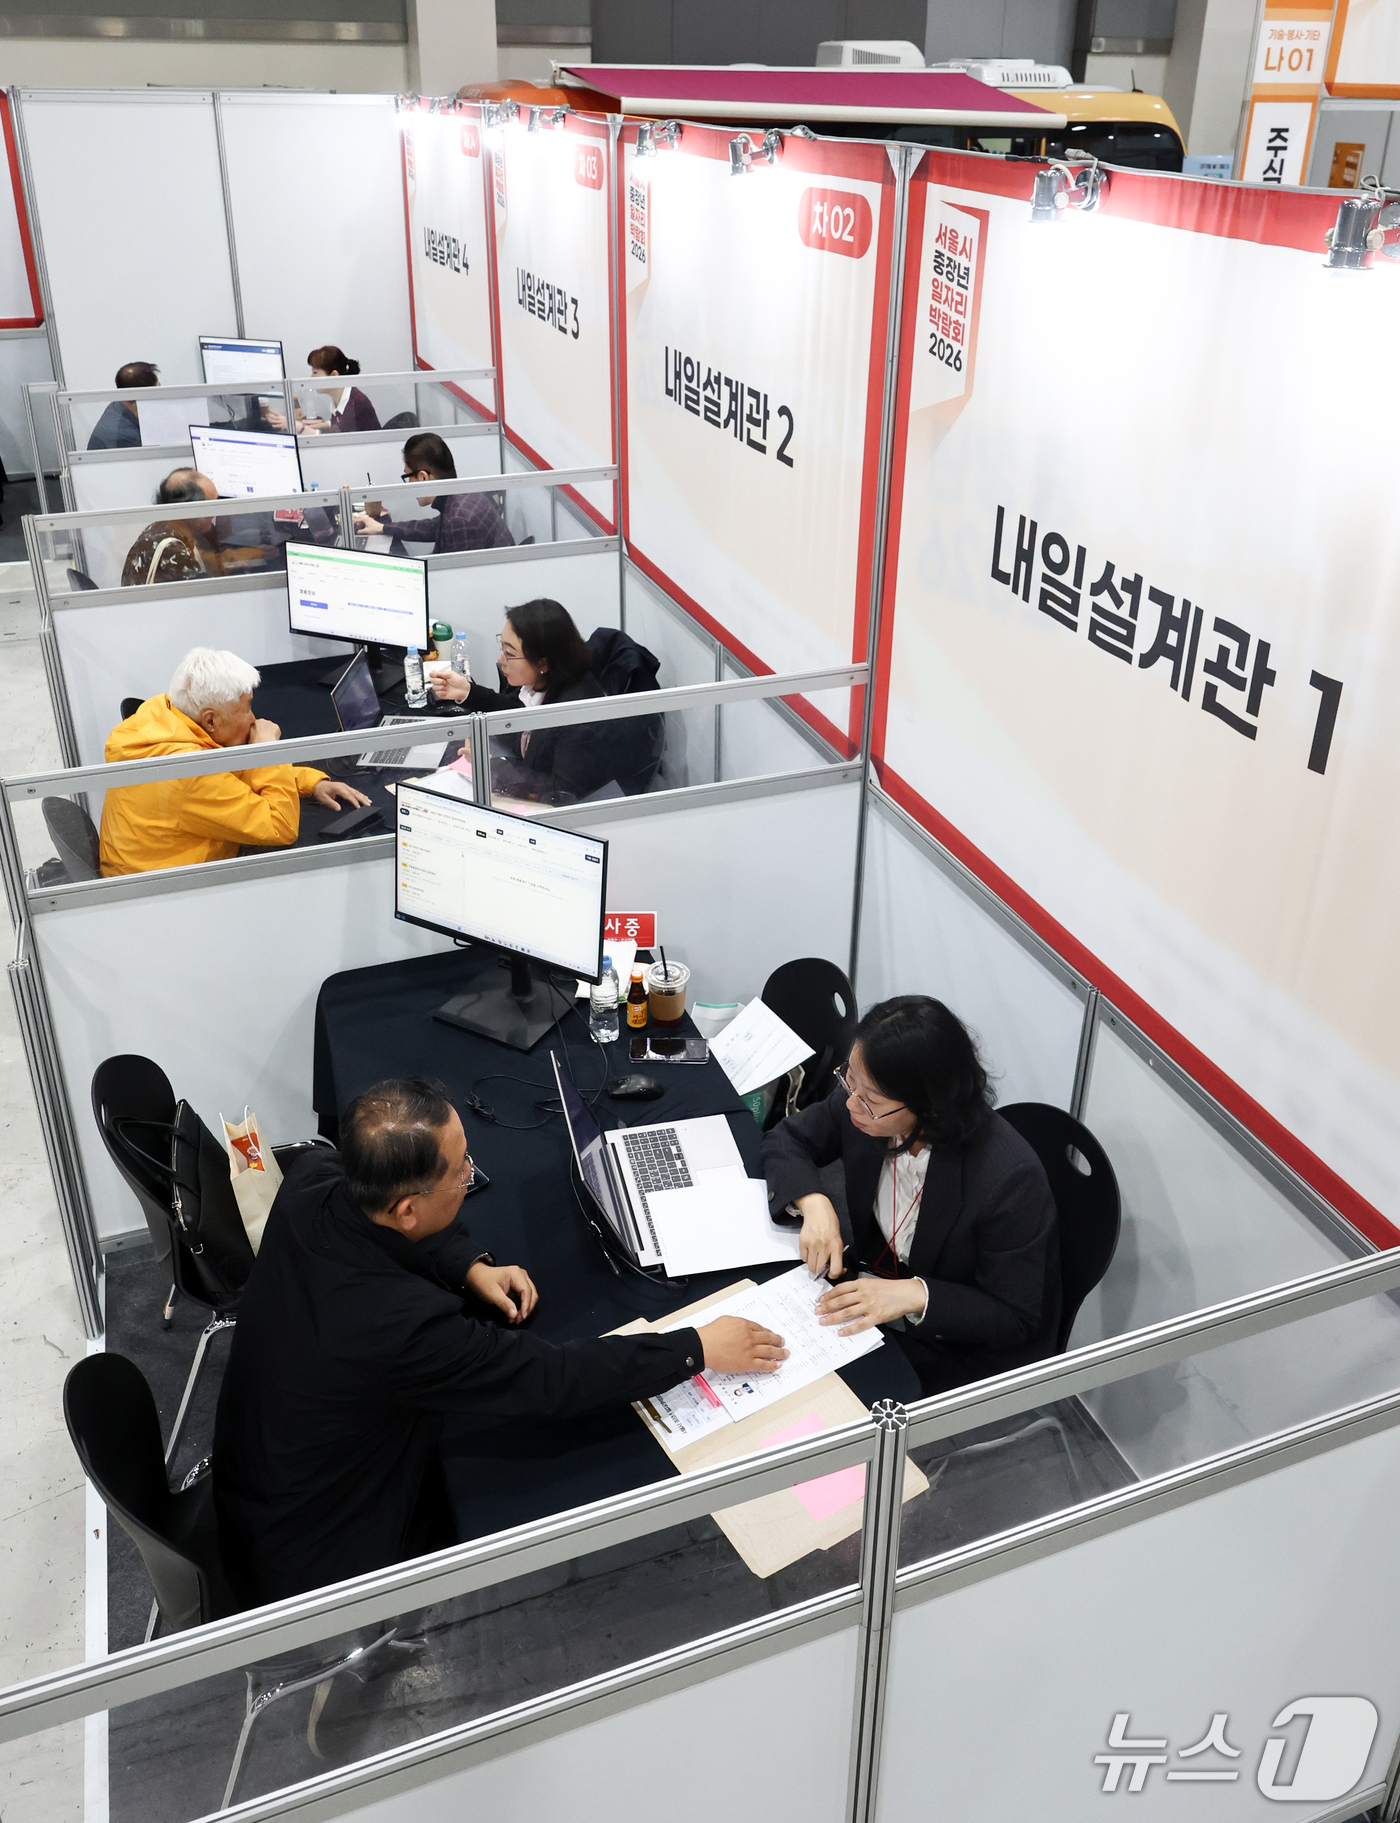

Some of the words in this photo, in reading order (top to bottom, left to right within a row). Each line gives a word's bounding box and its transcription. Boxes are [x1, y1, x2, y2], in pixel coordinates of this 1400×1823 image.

[811, 200, 856, 243] 차02
[935, 222, 973, 263] 서울시
[423, 226, 460, 274] 내일설계관
[462, 243, 469, 276] 4
[630, 240, 646, 264] 2026
[932, 249, 970, 291] 중장년
[516, 266, 568, 335] 내일설계관
[571, 296, 580, 340] 3
[931, 277, 968, 319] 일자리
[928, 304, 965, 346] 박람회
[928, 332, 963, 373] 2026
[664, 345, 770, 455] 내일설계관
[776, 404, 794, 469] 2
[990, 504, 1277, 742] 내일설계관
[1306, 668, 1344, 776] 1
